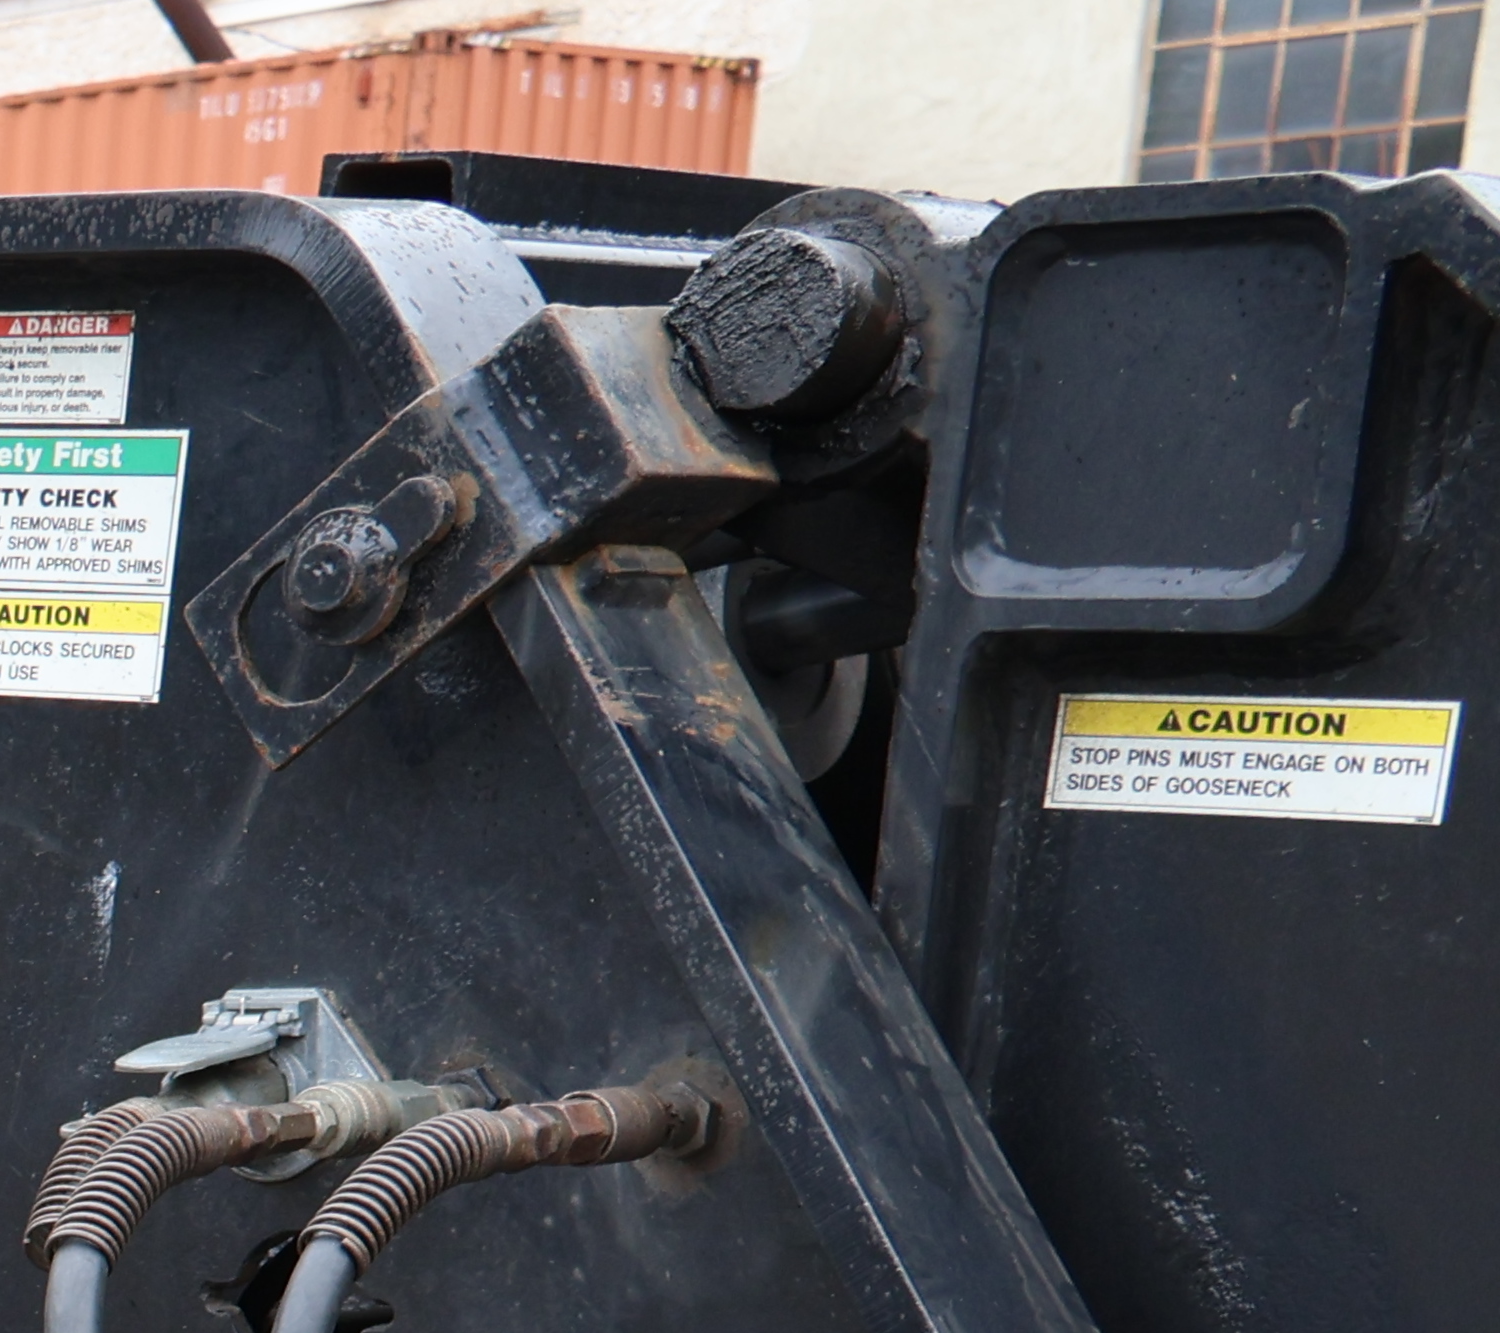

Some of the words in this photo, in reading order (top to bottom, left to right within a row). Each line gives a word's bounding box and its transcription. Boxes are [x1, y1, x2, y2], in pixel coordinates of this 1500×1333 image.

[26, 317, 109, 334] DANGER
[27, 345, 48, 355] keep
[51, 344, 98, 353] removable
[101, 344, 122, 353] riser
[18, 360, 49, 368] secure.
[22, 375, 30, 383] to
[33, 375, 66, 385] comply
[69, 375, 85, 383] can
[15, 389, 23, 397] in
[26, 389, 63, 399] property
[67, 389, 104, 398] damage,
[64, 403, 91, 412] death.
[53, 442, 123, 468] First
[40, 489, 119, 508] CHECK
[11, 517, 94, 532] REMOVABLE
[101, 519, 147, 532] SHIMS
[8, 536, 50, 550] SHOW
[92, 538, 132, 553] WEAR
[36, 557, 110, 572] APPROVED
[117, 559, 163, 574] SHIMS
[61, 642, 135, 660] SECURED
[9, 665, 39, 680] USE
[1189, 711, 1346, 736] CAUTION
[1070, 748, 1119, 766] STOP
[1128, 750, 1170, 768] PINS
[1179, 751, 1234, 770] MUST
[1243, 754, 1325, 773] ENGAGE
[1335, 756, 1364, 774] ON
[1374, 759, 1429, 776] BOTH
[1066, 775, 1122, 791] SIDES
[1132, 776, 1158, 793] OF
[1167, 779, 1292, 798] GOOSENECK
